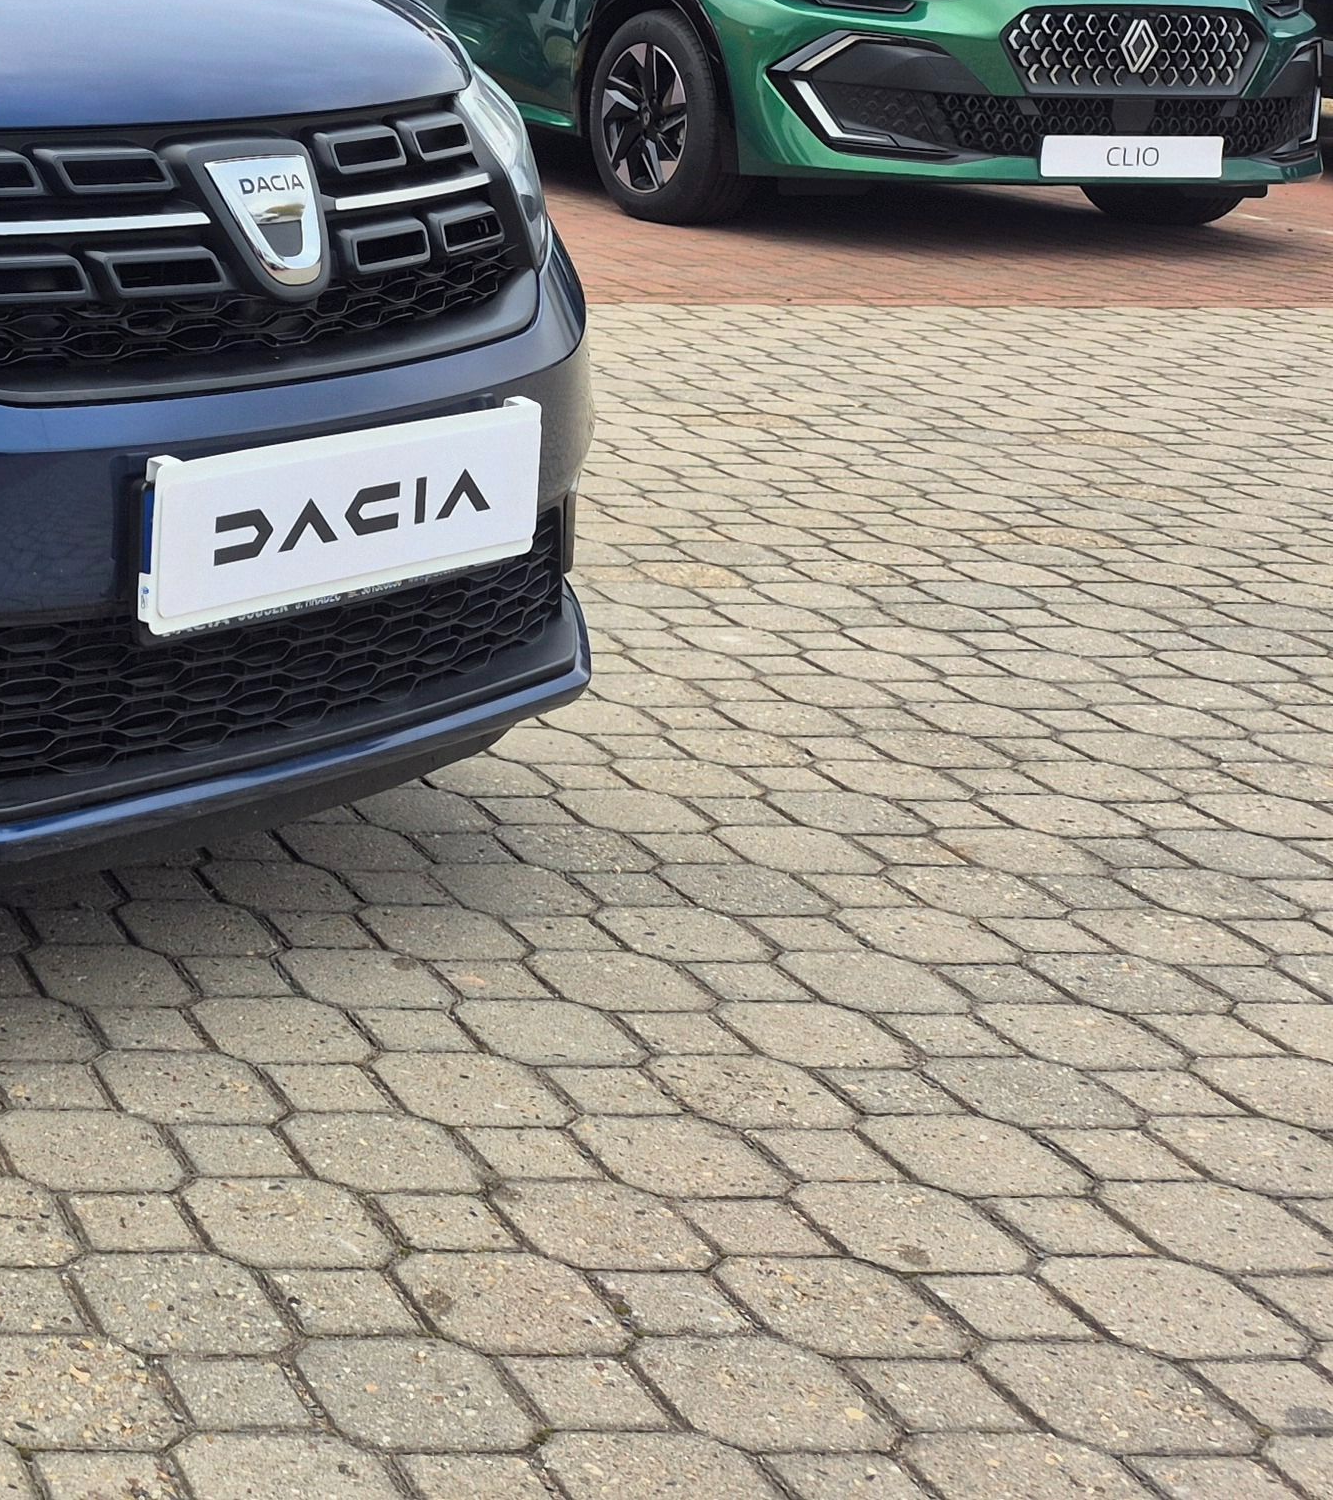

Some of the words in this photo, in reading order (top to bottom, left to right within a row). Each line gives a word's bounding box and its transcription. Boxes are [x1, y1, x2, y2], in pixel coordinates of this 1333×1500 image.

[1105, 146, 1160, 167] CLIO
[238, 174, 305, 195] DACIA
[213, 468, 491, 567] DACIA
